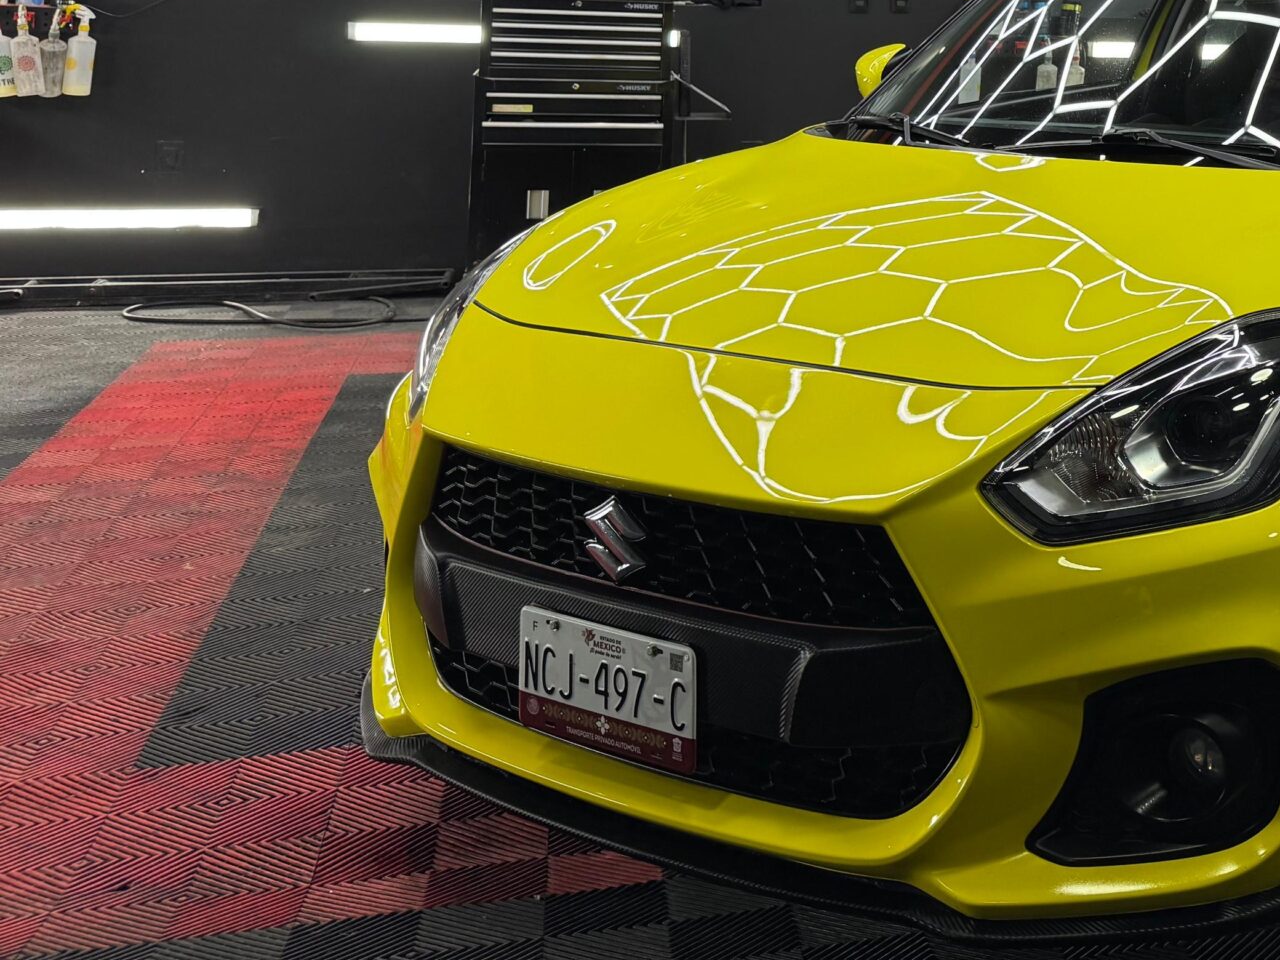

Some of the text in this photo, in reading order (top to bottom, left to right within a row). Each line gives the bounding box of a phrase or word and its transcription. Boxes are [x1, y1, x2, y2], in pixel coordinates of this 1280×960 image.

[524, 637, 686, 731] NCJ-497-C
[566, 725, 594, 740] TRANSPORTE
[594, 733, 615, 746] PRIVADO
